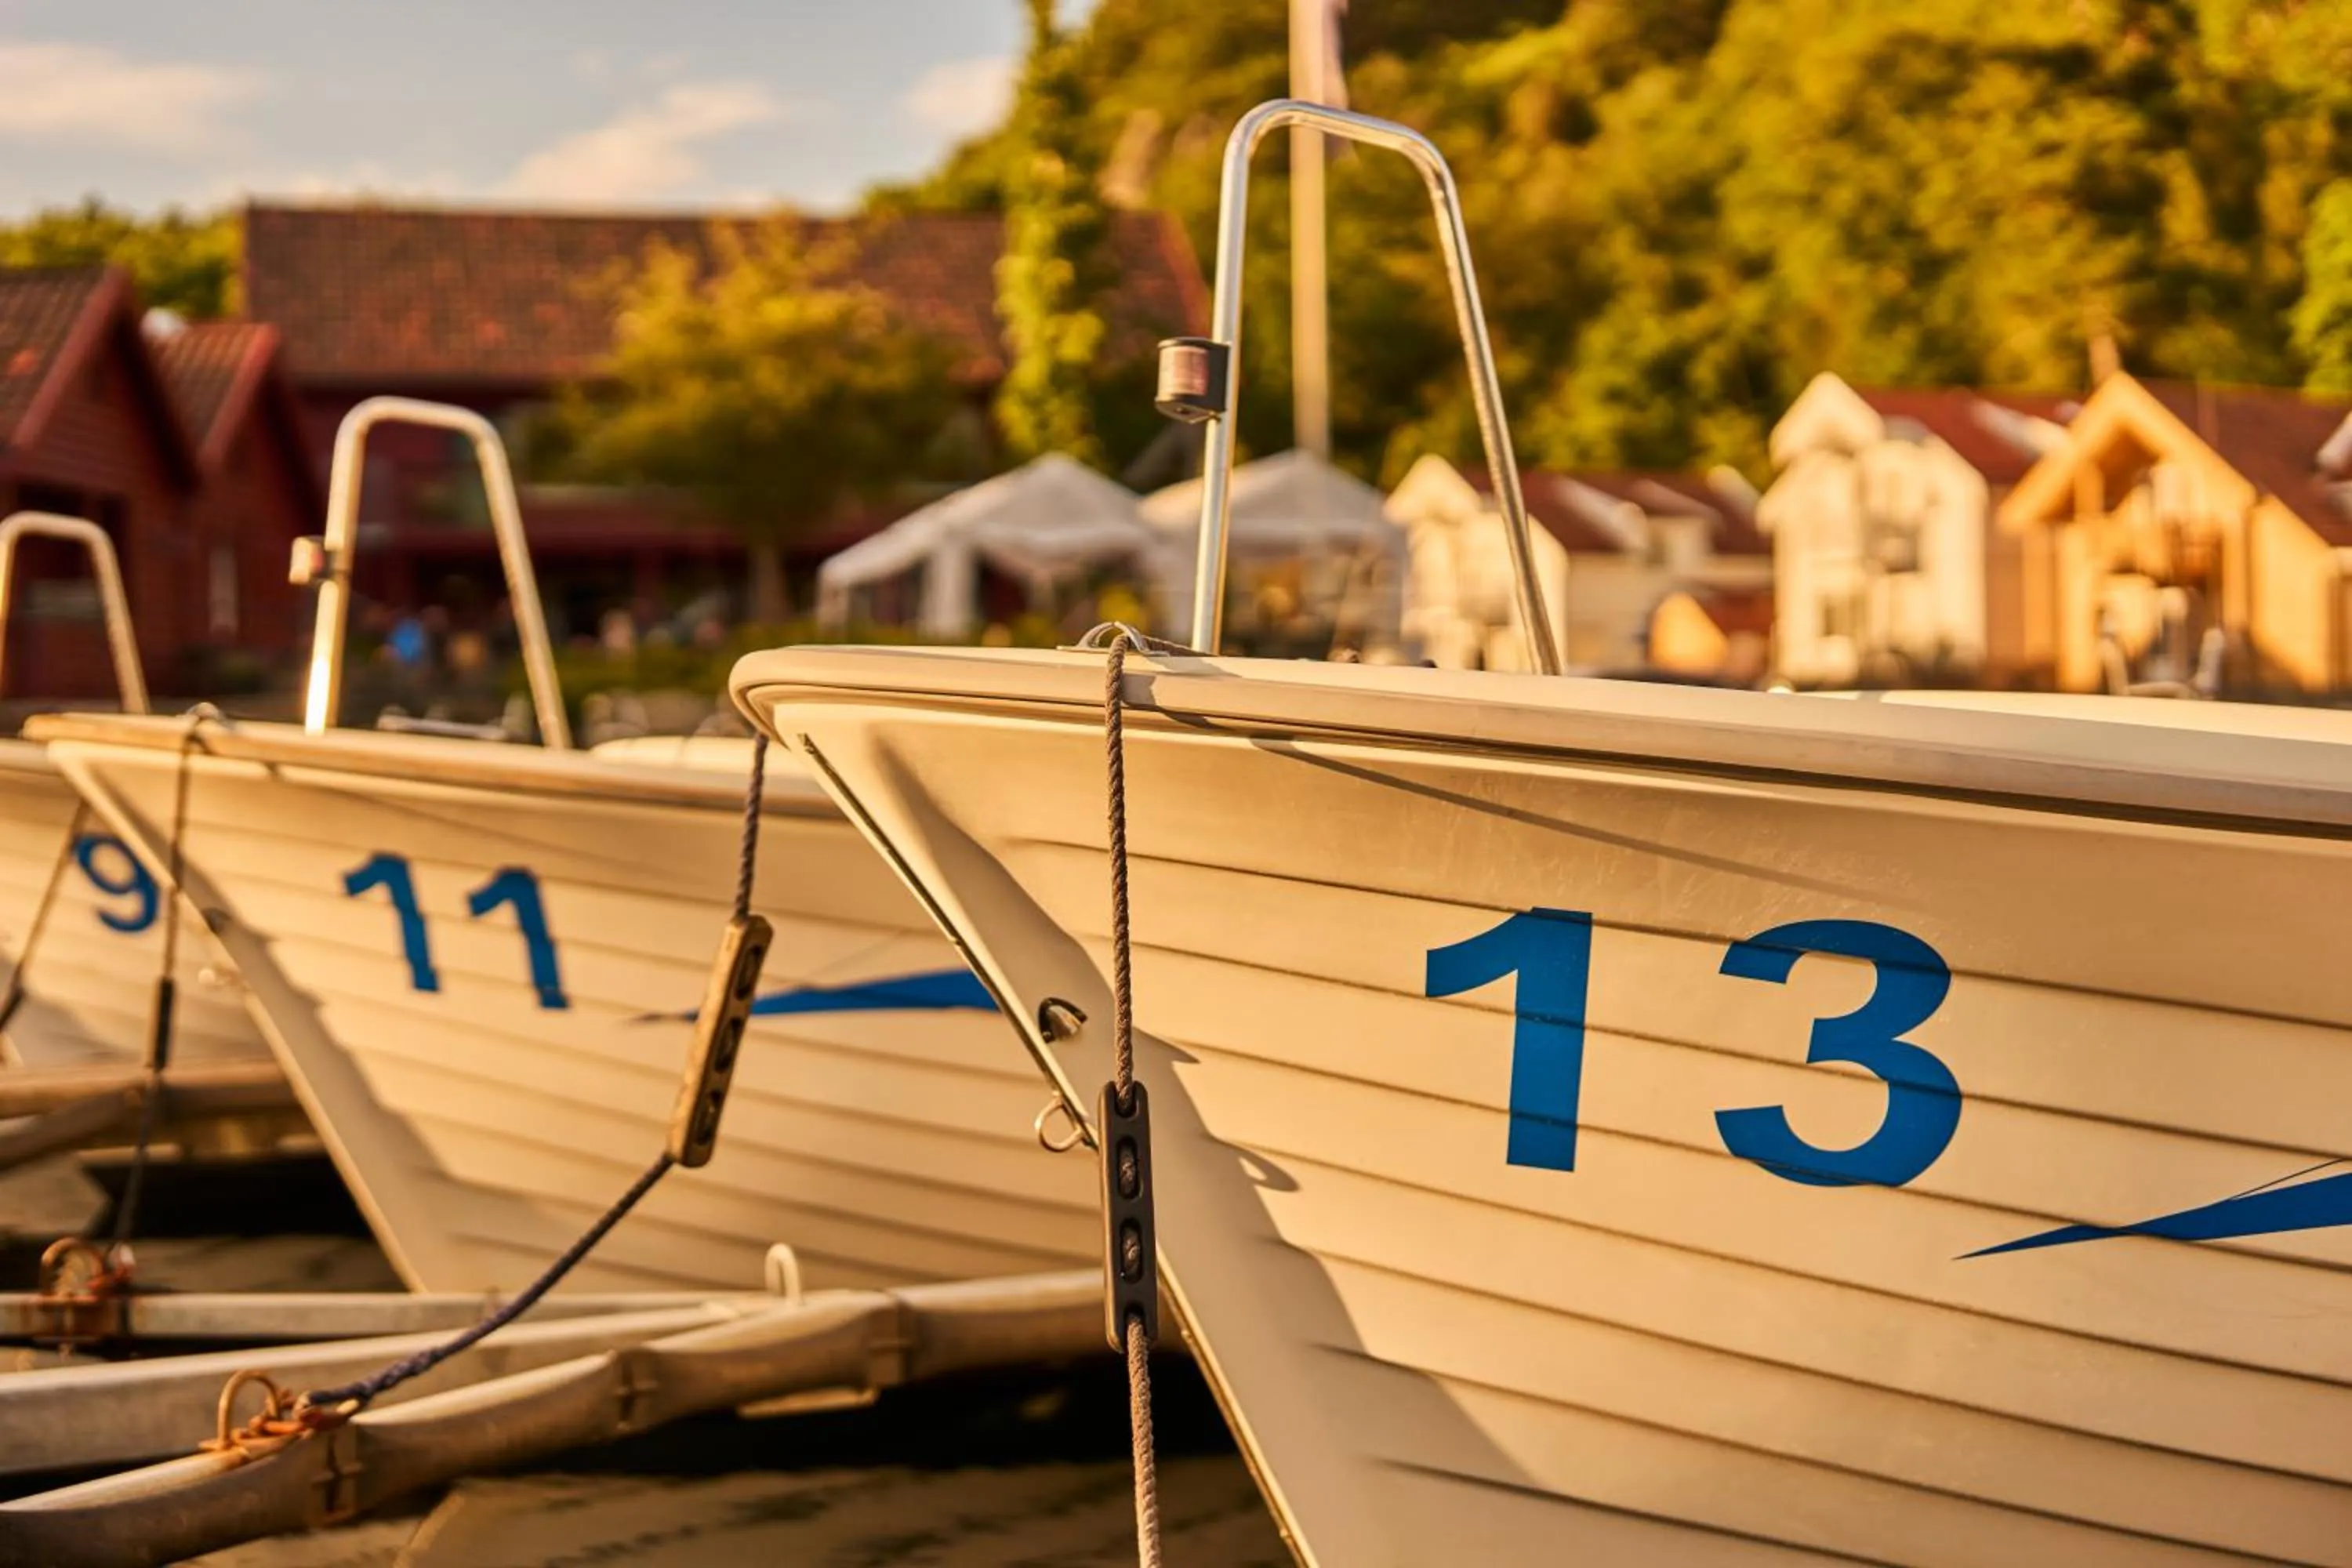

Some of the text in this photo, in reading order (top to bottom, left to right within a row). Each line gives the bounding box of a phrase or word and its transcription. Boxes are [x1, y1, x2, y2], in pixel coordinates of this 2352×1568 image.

[73, 834, 159, 933] 9
[343, 851, 570, 1009] 11
[1425, 907, 1962, 1187] 13
